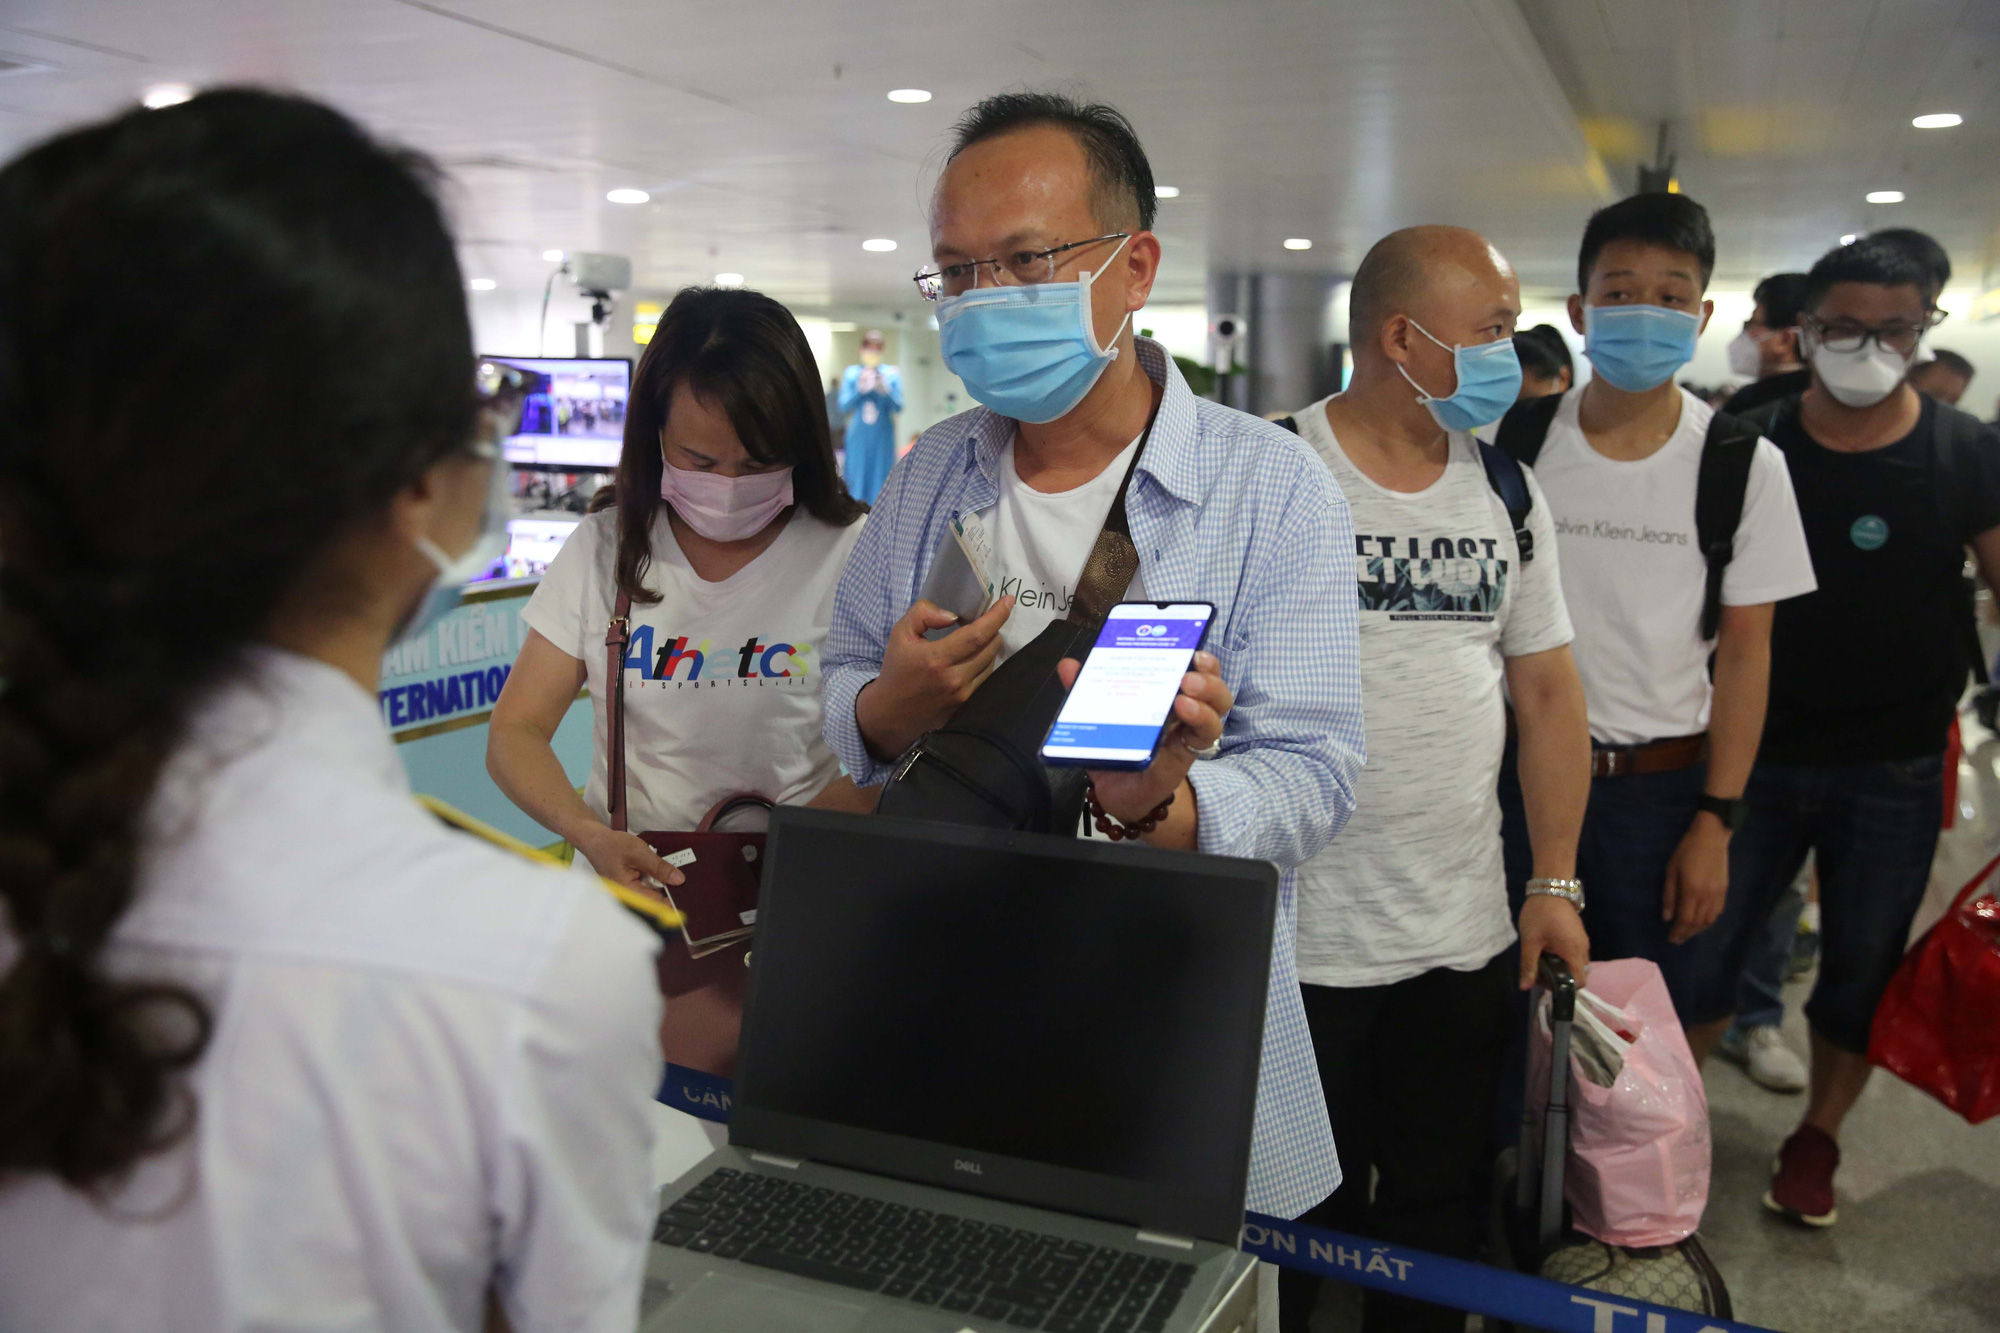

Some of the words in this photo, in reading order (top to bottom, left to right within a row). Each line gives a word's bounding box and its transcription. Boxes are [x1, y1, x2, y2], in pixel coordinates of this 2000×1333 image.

[1555, 518, 1590, 536] alvin
[1593, 519, 1635, 540] Klein
[1635, 525, 1688, 546] Jeans
[1355, 534, 1397, 584] ET
[1408, 537, 1498, 586] LOST
[1000, 576, 1055, 611] Klein
[1057, 585, 1074, 611] Je
[381, 630, 431, 679] AM
[954, 1159, 983, 1175] DELL
[1241, 1222, 1297, 1254] ƠN
[1309, 1238, 1414, 1282] NHẤT
